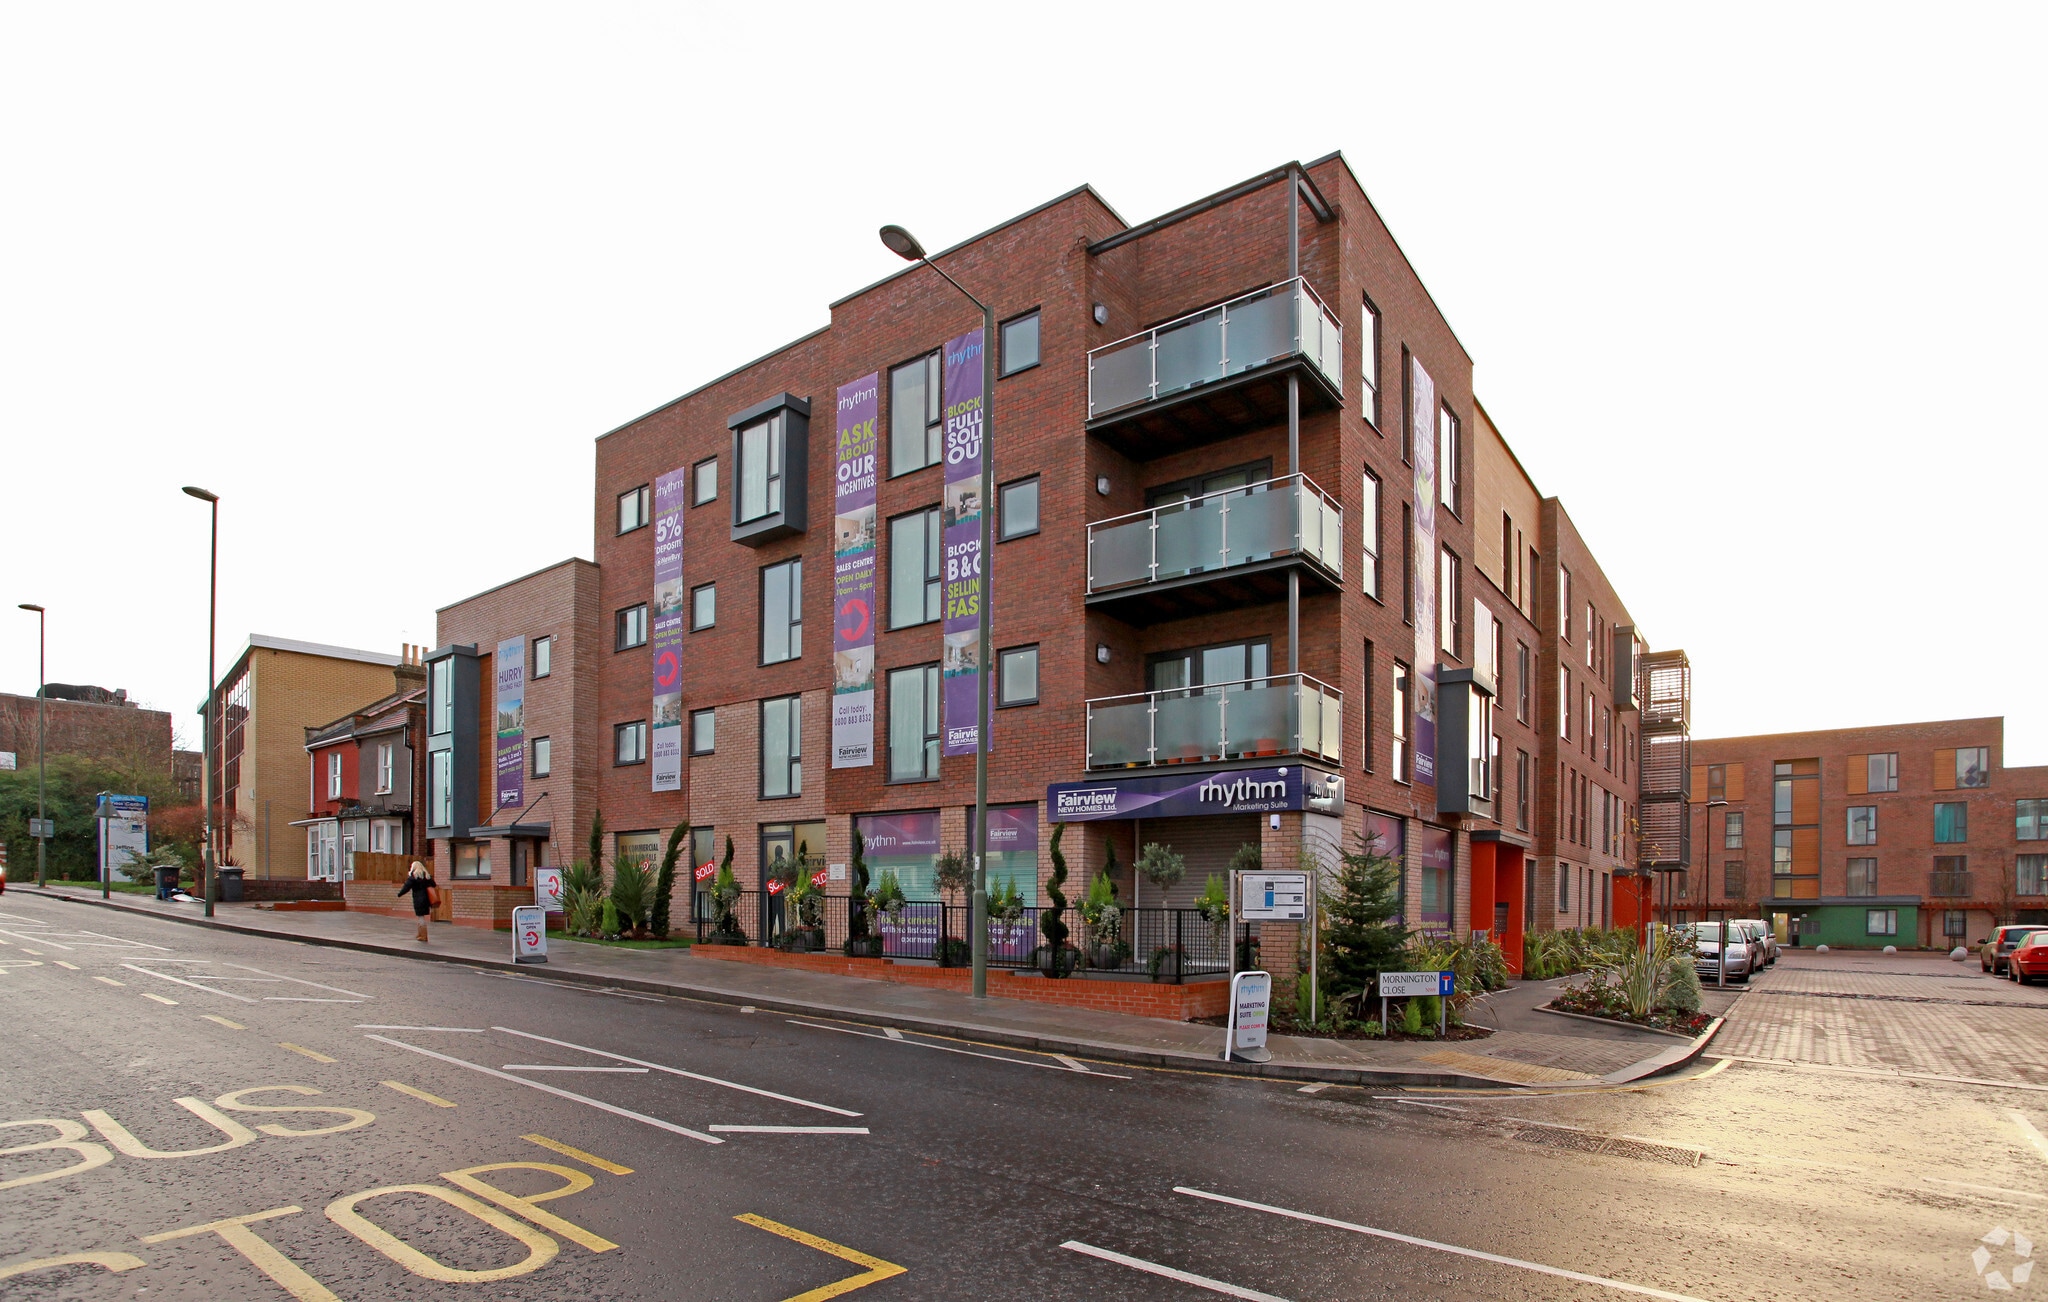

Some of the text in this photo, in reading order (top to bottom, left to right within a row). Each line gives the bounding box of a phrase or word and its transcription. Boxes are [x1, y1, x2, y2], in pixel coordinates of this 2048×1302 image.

[839, 388, 876, 410] rhythm
[839, 418, 875, 449] ASK
[839, 439, 874, 462] ABOUT
[948, 438, 982, 464] OU
[838, 454, 873, 482] OUR
[657, 480, 682, 496] rhythm
[838, 474, 874, 497] INCENTIVES
[657, 513, 681, 542] 5%
[656, 541, 681, 554] DEPOSIT!
[837, 556, 873, 573] SALES CENTRE
[836, 569, 872, 584] OPEN DAILY
[860, 582, 872, 591] 5pm
[948, 578, 979, 599] SELLIN
[948, 595, 978, 619] FAS
[655, 617, 680, 630] SALES CENTRE
[668, 628, 680, 636] DAILY
[499, 666, 523, 683] HURRY
[499, 683, 513, 692] SELLING
[839, 704, 867, 714] Call today:
[835, 717, 846, 726] 0800
[848, 715, 857, 724] 883
[949, 729, 978, 740] Fairvie
[839, 747, 867, 755] Fairview
[1416, 753, 1432, 769] Fairview
[1058, 792, 1116, 806] Fairview
[1200, 777, 1286, 807] rhythm
[1233, 801, 1269, 810] Marketing
[629, 843, 658, 852] COMMERCIAL
[696, 863, 714, 879] SOLD
[1382, 975, 1436, 983] MORNINGTON
[1241, 984, 1264, 995] rhythm
[0, 1085, 376, 1189] BUS
